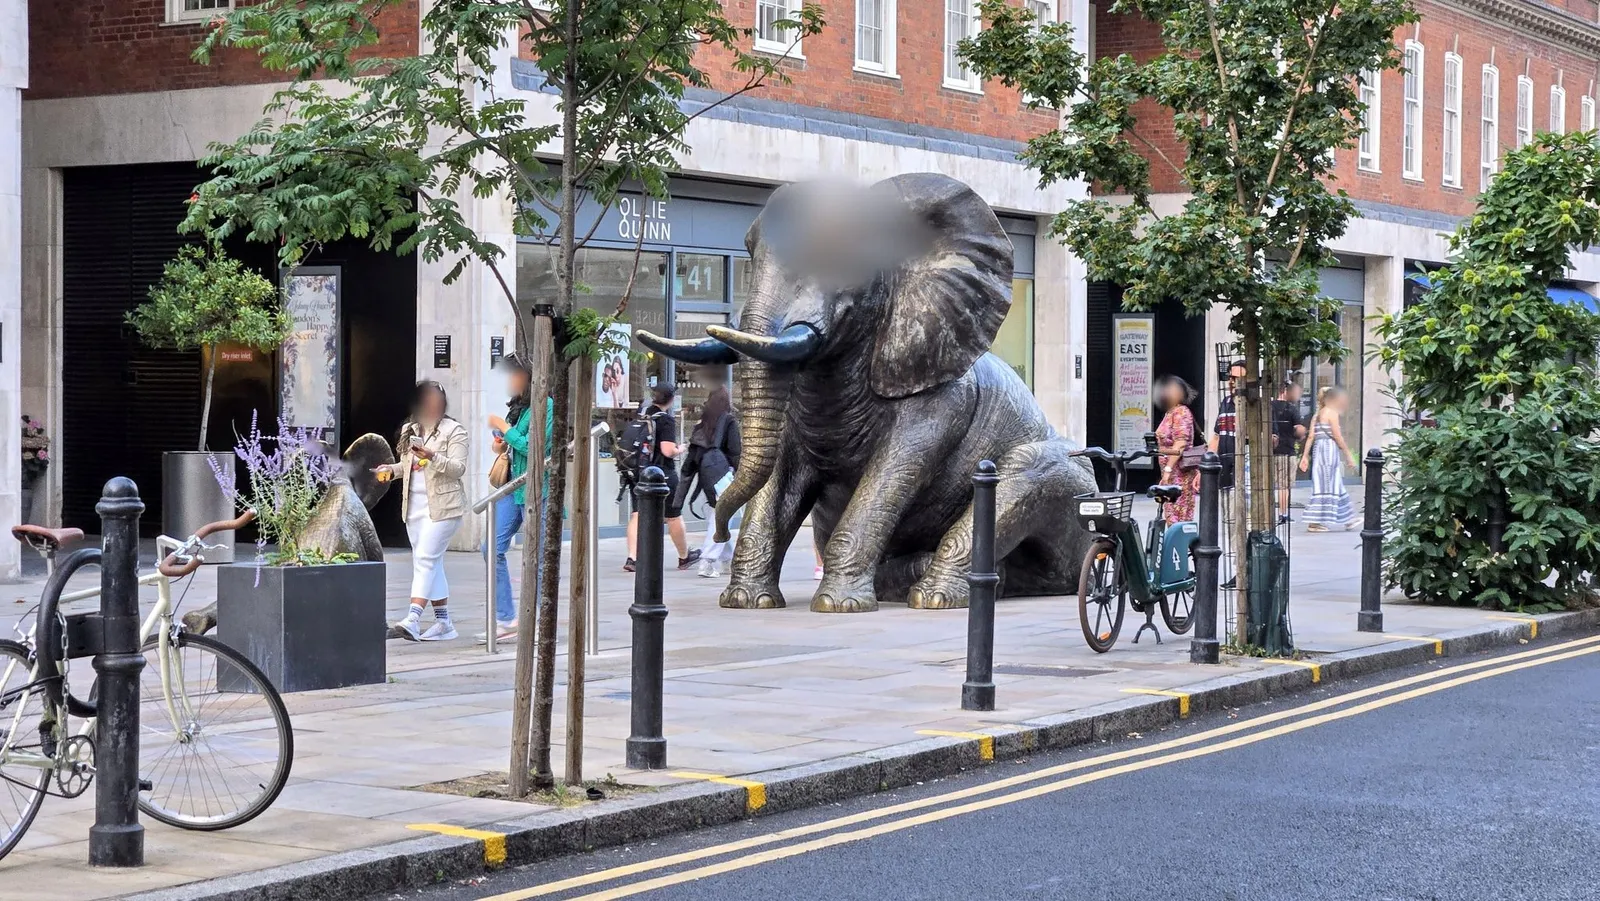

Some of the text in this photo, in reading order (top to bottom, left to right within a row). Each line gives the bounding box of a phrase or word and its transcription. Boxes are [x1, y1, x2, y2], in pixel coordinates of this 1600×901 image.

[618, 220, 670, 240] QUINN
[687, 265, 712, 292] 41
[306, 321, 329, 333] Happy
[295, 332, 317, 340] Secret
[1120, 344, 1147, 354] EAST
[222, 352, 230, 360] Dry
[1154, 531, 1164, 569] forest
